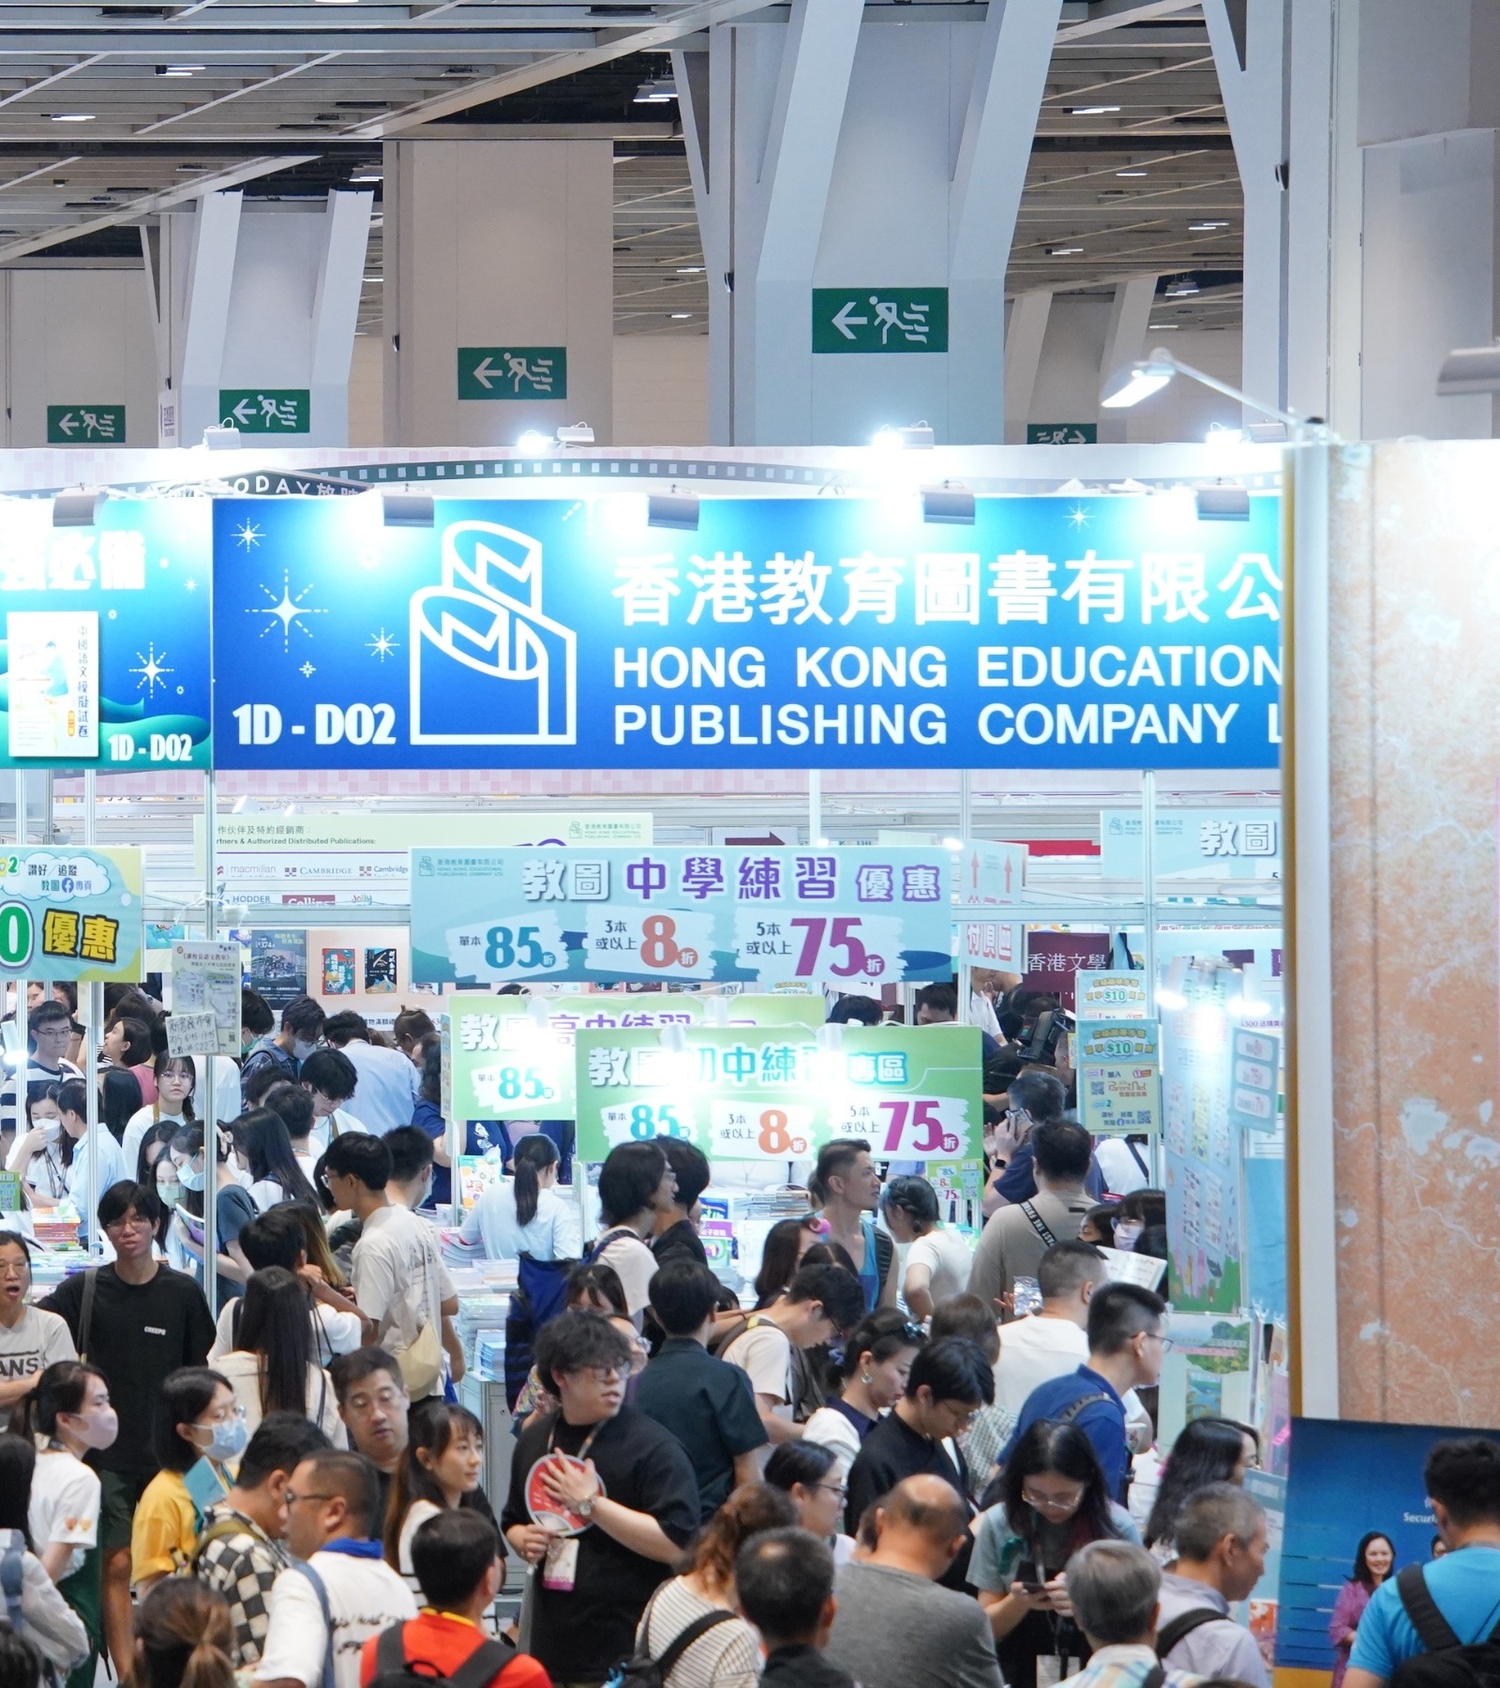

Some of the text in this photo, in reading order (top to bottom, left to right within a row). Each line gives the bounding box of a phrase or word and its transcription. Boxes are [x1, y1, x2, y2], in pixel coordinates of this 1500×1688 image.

[615, 646, 765, 688] HONG
[798, 646, 947, 688] KONG
[232, 704, 283, 745] 1D
[315, 703, 396, 745] D02
[615, 703, 947, 746] PUBLISHING
[978, 702, 1238, 745] COMPANY
[108, 734, 134, 761] 1D
[150, 733, 193, 761] D02
[247, 837, 286, 845] Authorized
[288, 837, 328, 845] Distributed
[1200, 820, 1277, 857] 教圖
[8, 857, 18, 873] 2
[230, 864, 276, 874] macmillan
[299, 867, 353, 876] CAMBRIDGE
[522, 857, 940, 903] 教圖 中學練習 優惠
[232, 895, 271, 904] HODDER
[605, 920, 627, 932] 3本
[756, 922, 781, 936] 5本
[42, 908, 119, 963] 優惠
[459, 935, 482, 946] 單本
[595, 937, 638, 950] 或以上
[746, 941, 792, 955] 或以上
[1028, 952, 1107, 972] 香港文學
[1107, 1040, 1132, 1053] $10
[850, 1106, 870, 1117] 5本
[728, 1114, 747, 1125] 3本
[720, 1128, 755, 1139] 或以上
[841, 1122, 881, 1133] 或以上
